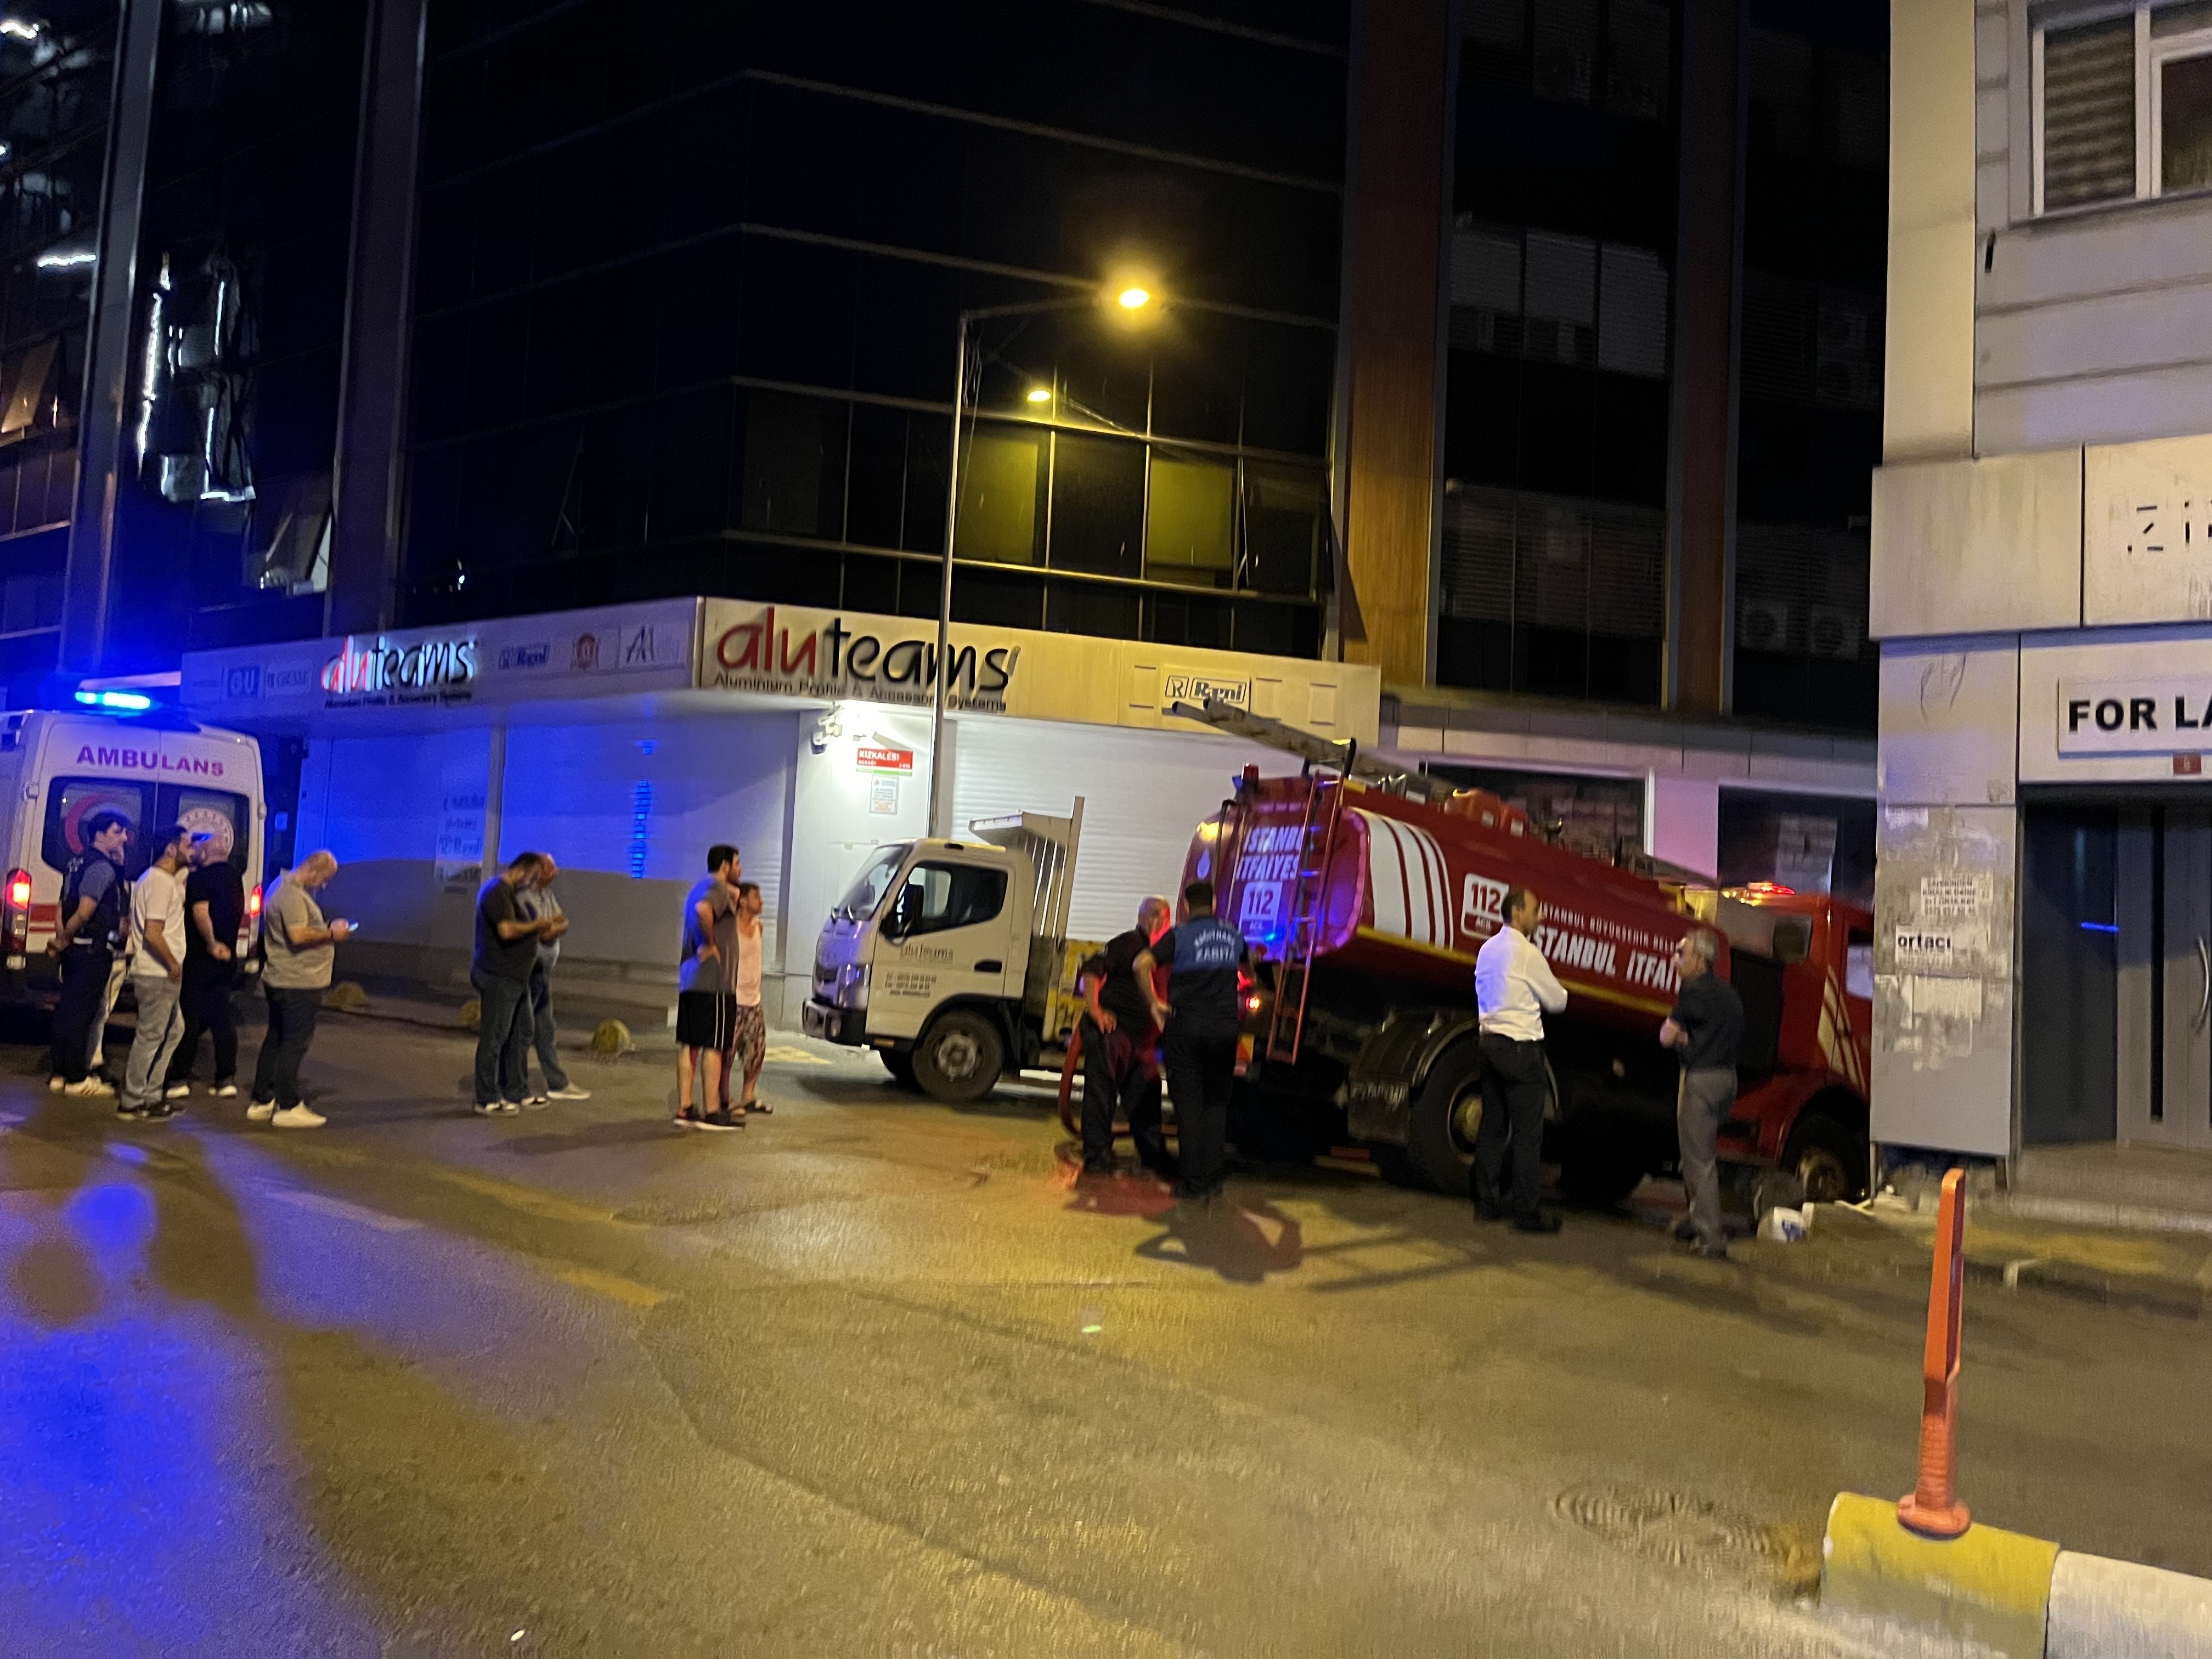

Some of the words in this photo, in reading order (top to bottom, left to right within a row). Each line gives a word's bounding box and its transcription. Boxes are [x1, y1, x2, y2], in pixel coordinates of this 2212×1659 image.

[320, 634, 476, 694] aluteams
[717, 606, 1021, 692] aluteams
[2069, 698, 2157, 733] FOR
[76, 744, 223, 777] AMBULANS
[1248, 889, 1274, 915] 112
[1471, 881, 1500, 915] 112
[1527, 924, 1616, 978] STANBUL
